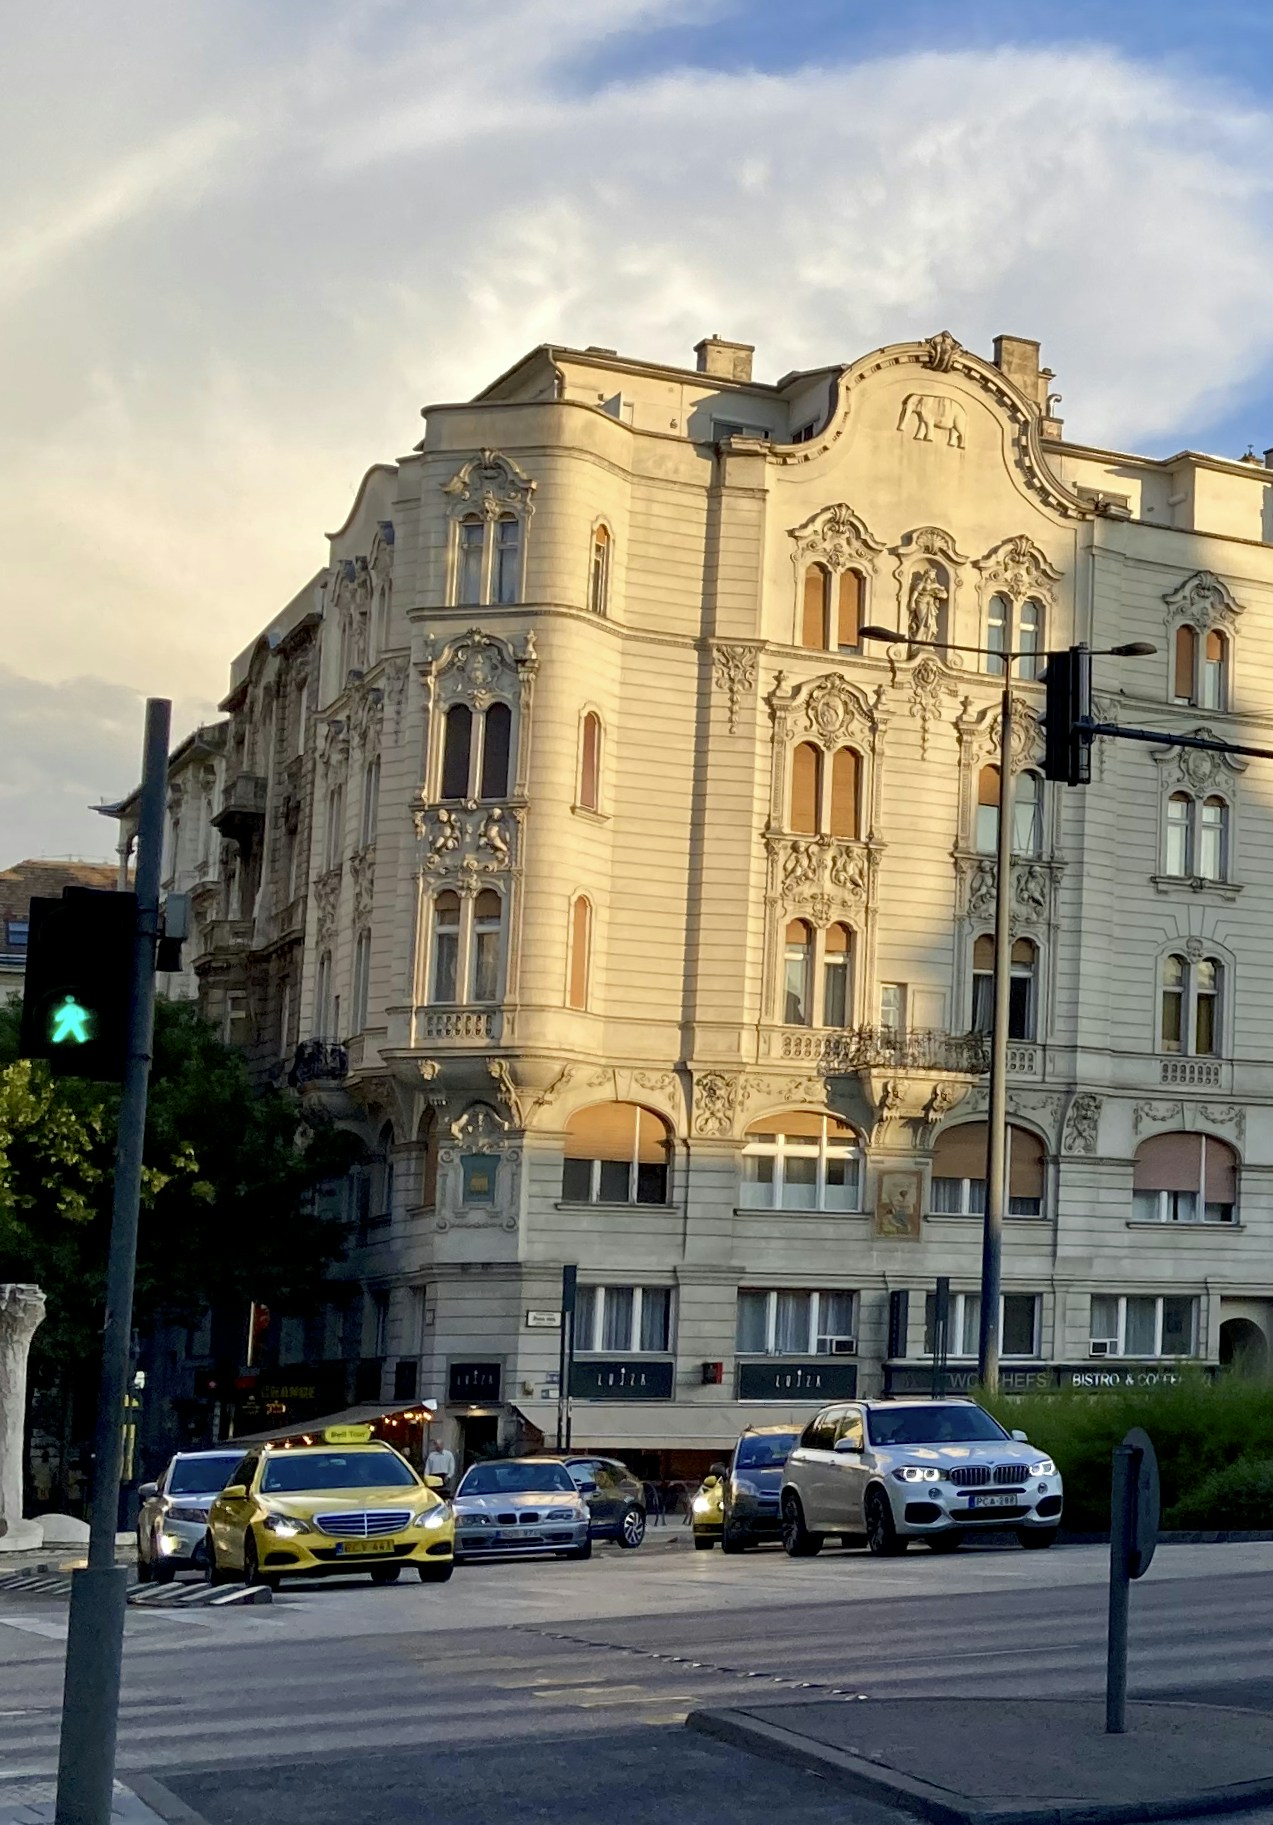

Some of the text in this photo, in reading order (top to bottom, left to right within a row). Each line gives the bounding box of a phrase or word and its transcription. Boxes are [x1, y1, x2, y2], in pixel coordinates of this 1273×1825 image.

[999, 1372, 1049, 1388] HEFS
[1072, 1373, 1120, 1387] BISTRO
[1125, 1373, 1134, 1386] &
